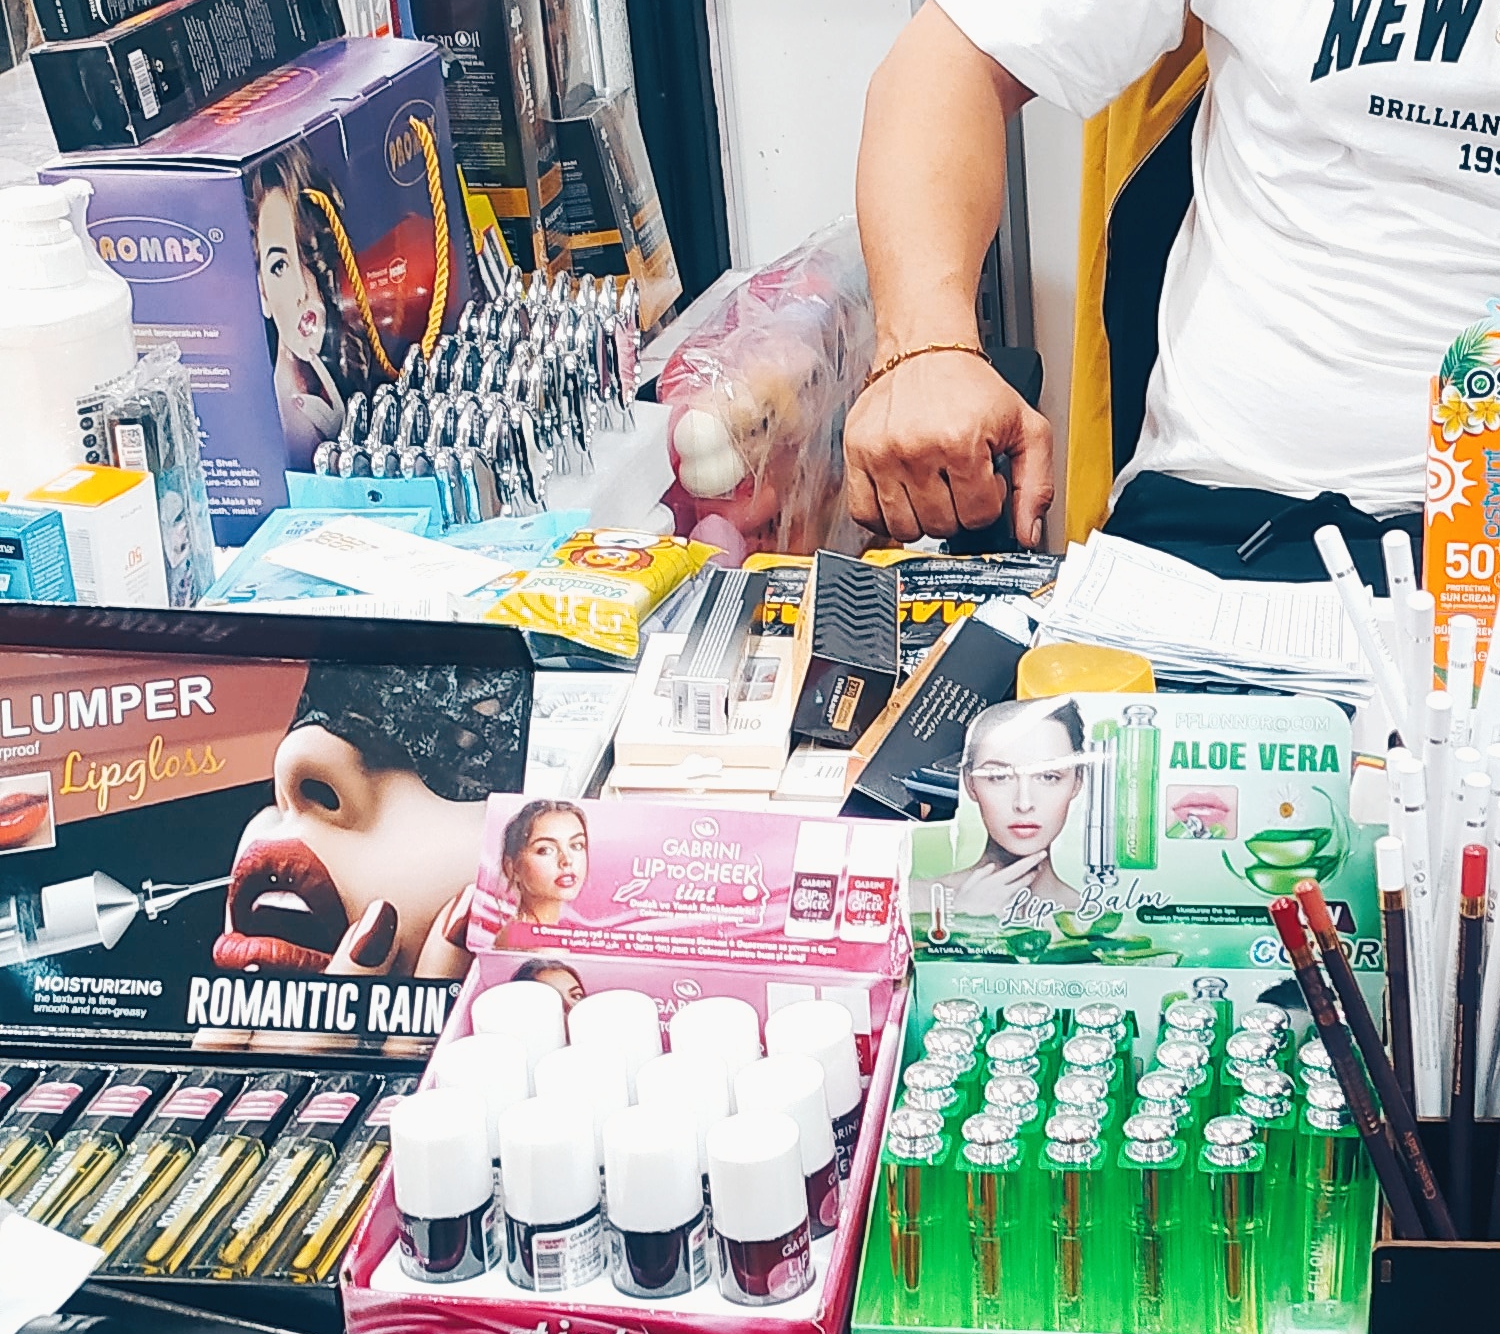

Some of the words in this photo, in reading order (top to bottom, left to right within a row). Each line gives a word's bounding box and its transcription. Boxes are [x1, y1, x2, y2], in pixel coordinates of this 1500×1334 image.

[1169, 740, 1247, 770] ALOE
[1257, 742, 1340, 773] VERA
[60, 734, 226, 813] Lipgloss
[662, 838, 742, 860] GABRINI
[674, 883, 717, 903] tint
[1002, 887, 1064, 926] Lip
[1076, 878, 1171, 922] Balm
[34, 975, 163, 997] MOISTURIZING
[34, 1003, 69, 1014] smooth
[71, 1004, 90, 1015] and
[187, 977, 359, 1031] ROMANTIC
